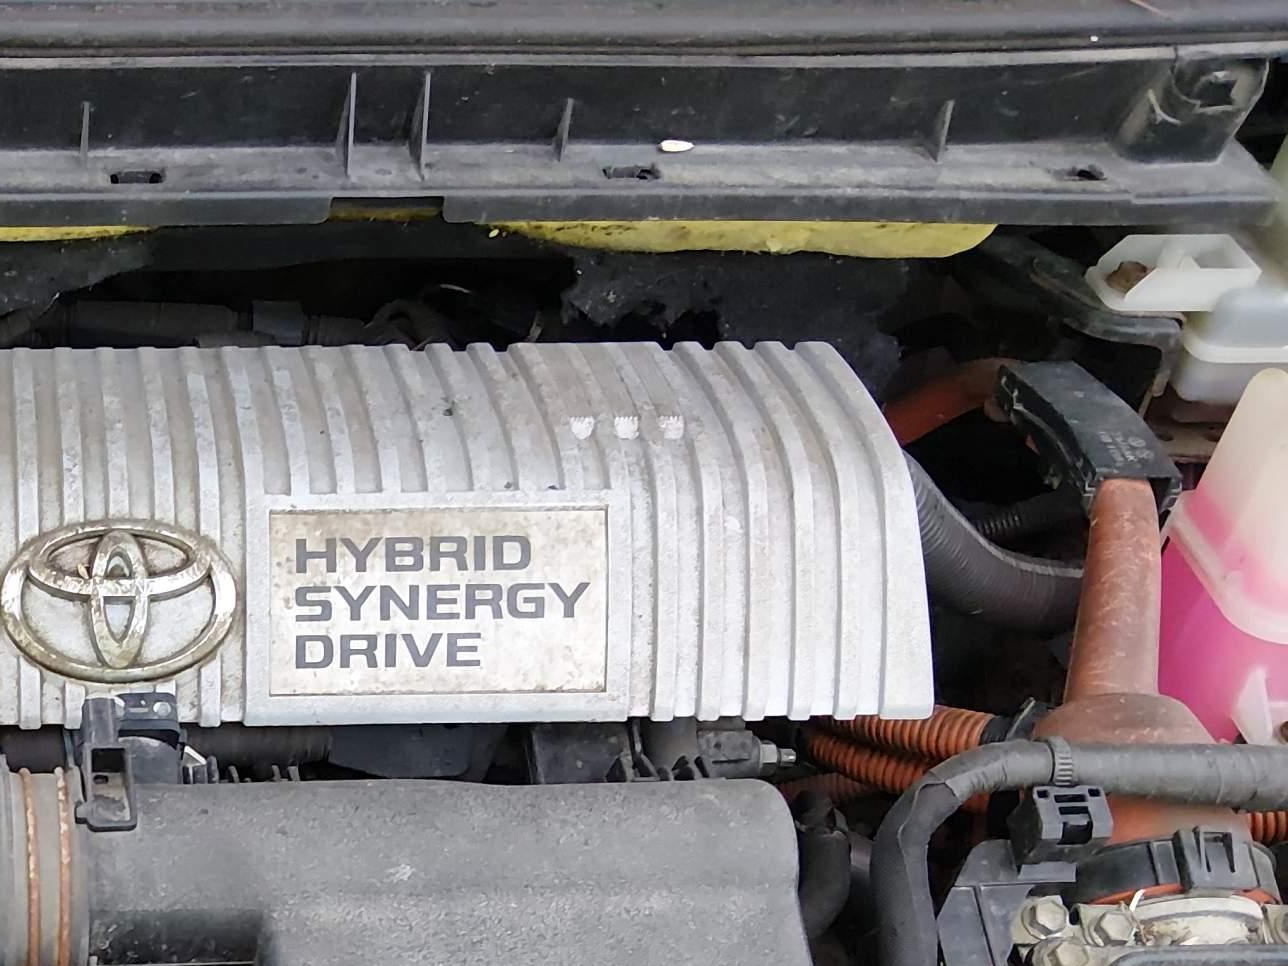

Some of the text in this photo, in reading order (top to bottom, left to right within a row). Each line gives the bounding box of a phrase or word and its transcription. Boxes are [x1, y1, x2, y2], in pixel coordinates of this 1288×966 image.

[295, 535, 532, 574] HYBRID
[295, 582, 591, 622] SYNERGY
[295, 633, 482, 669] DRIVE
